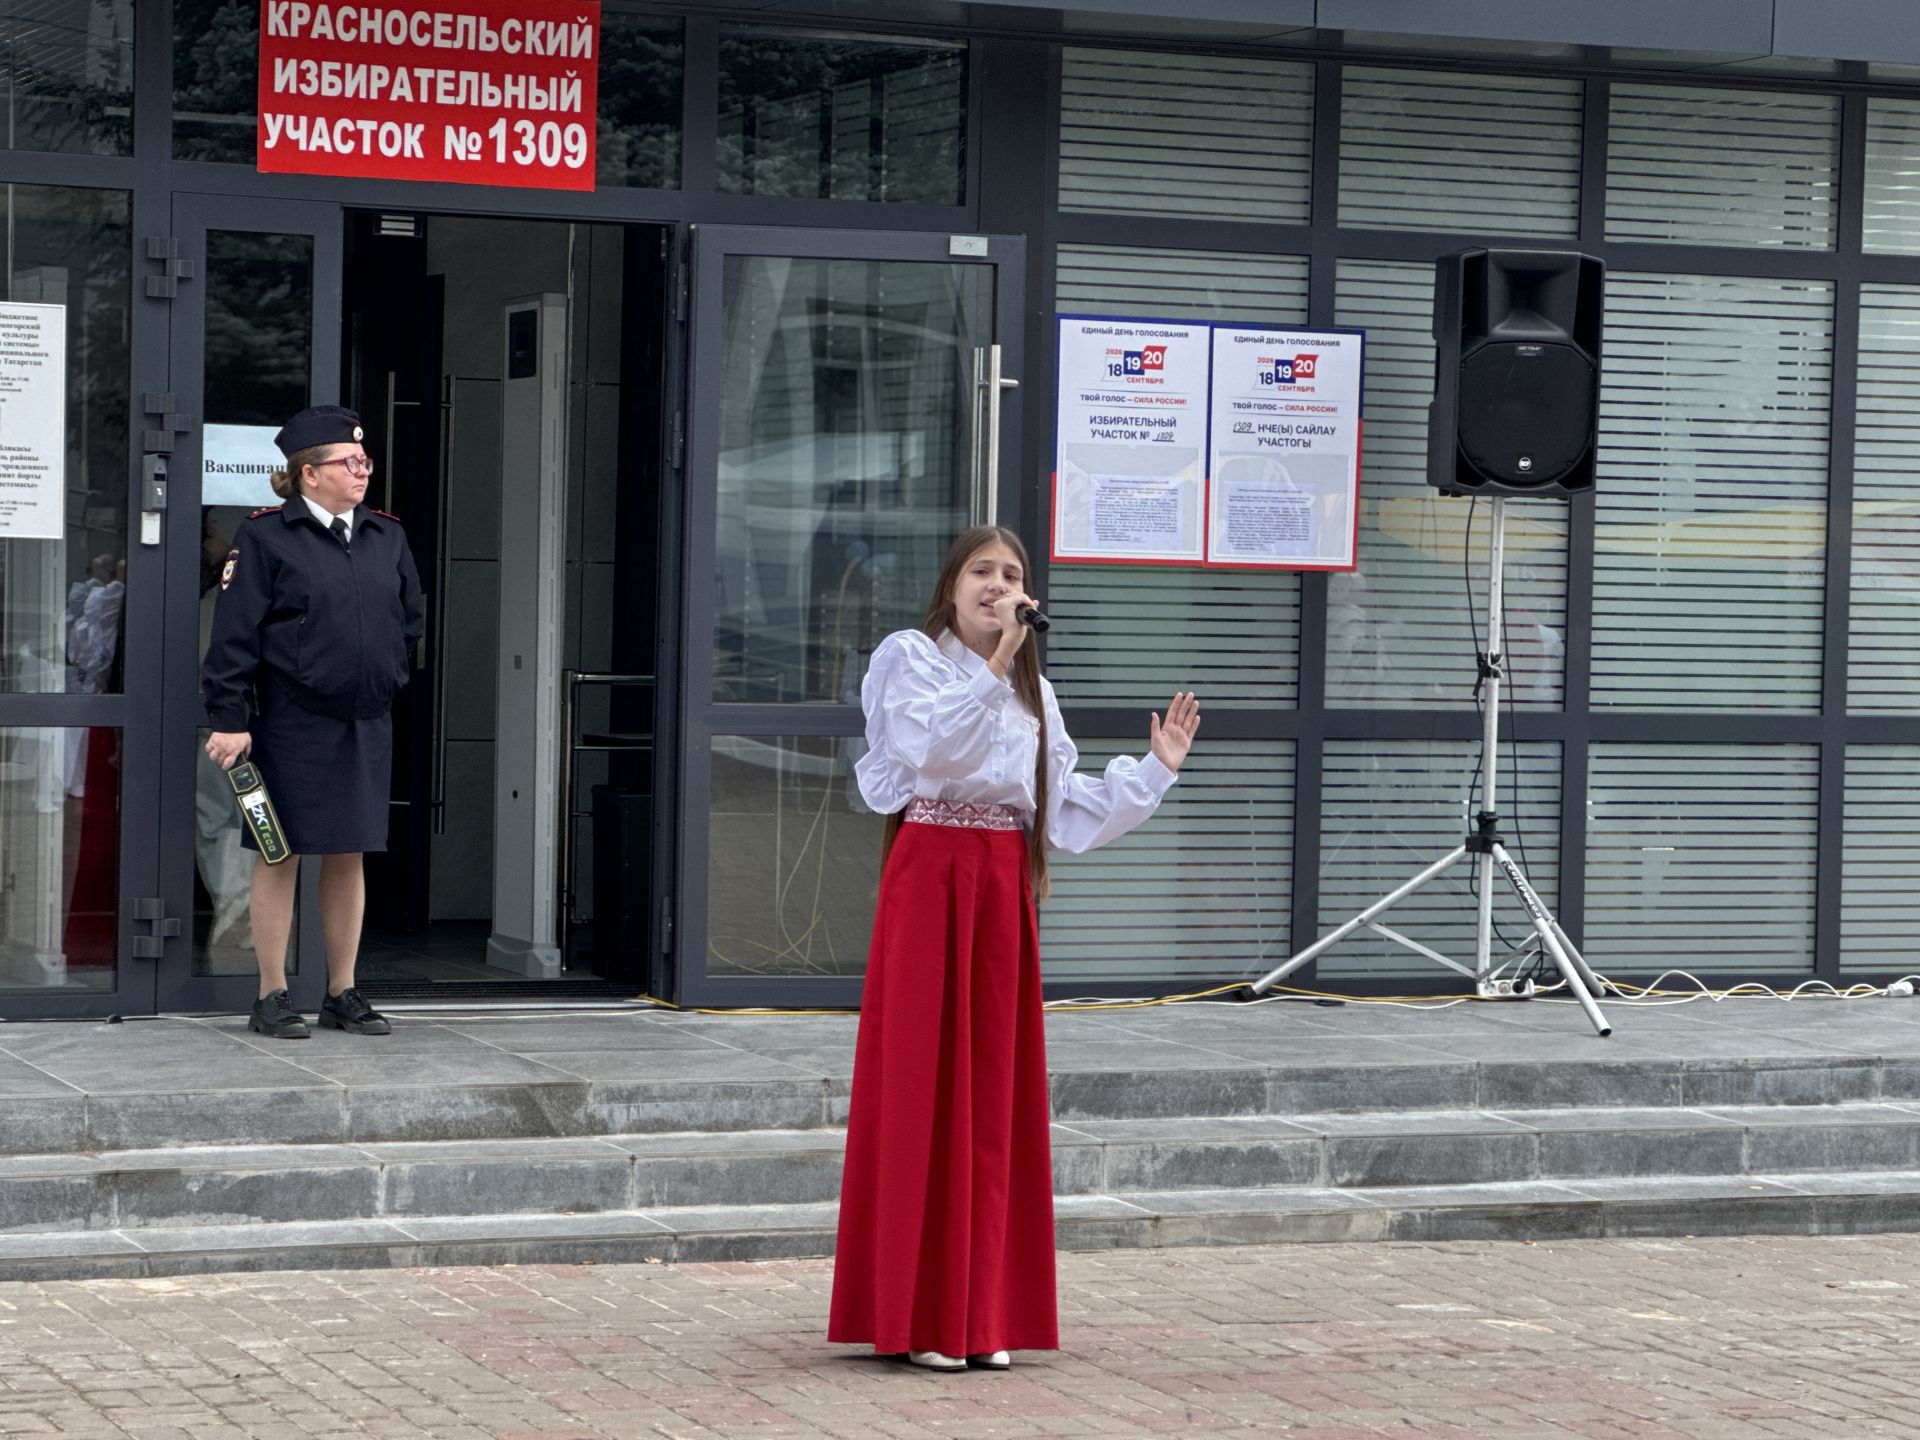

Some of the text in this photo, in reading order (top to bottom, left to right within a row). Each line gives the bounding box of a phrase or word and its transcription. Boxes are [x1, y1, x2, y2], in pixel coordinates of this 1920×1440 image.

[267, 0, 593, 59] КРАСНОСЕЛЬСКИЙ
[274, 57, 582, 113] ИЗБИРАТЕЛЬНЫЙ
[263, 113, 425, 159] УЧАСТОК
[0, 313, 38, 321] юджетное
[1081, 327, 1189, 338] ЕДИНЫЙ ДЕНЬ ГОЛОСОВАНИЯ
[1234, 336, 1340, 347] ЕДИНЫЙ ДЕНЬ ГОЛОСОВАНИЯ
[0, 350, 49, 358] иципального
[1108, 350, 1162, 377] 18 19 20
[1259, 359, 1313, 385] 18 19 20
[1126, 376, 1164, 384] СЕНТЯБРЯ
[1278, 385, 1315, 393] СЕНТЯБРЯ
[1101, 395, 1126, 403] ГОЛОС
[1134, 396, 1154, 404] СИЛА
[1155, 397, 1187, 405] РОССИИ!
[1233, 402, 1252, 410] ТВОЙ
[1253, 403, 1277, 411] ГОЛОС
[1089, 415, 1177, 428] ИЗБИРАТЕЛЬНЫЙ
[1091, 429, 1138, 440] УЧАСТОК
[1140, 431, 1150, 440] №
[1257, 423, 1293, 436] НЧЕ(Ы)
[1295, 425, 1336, 436] САЙЛАУ
[1258, 437, 1312, 448] УЧАСТОГЫ
[205, 459, 287, 475] Вакцинац
